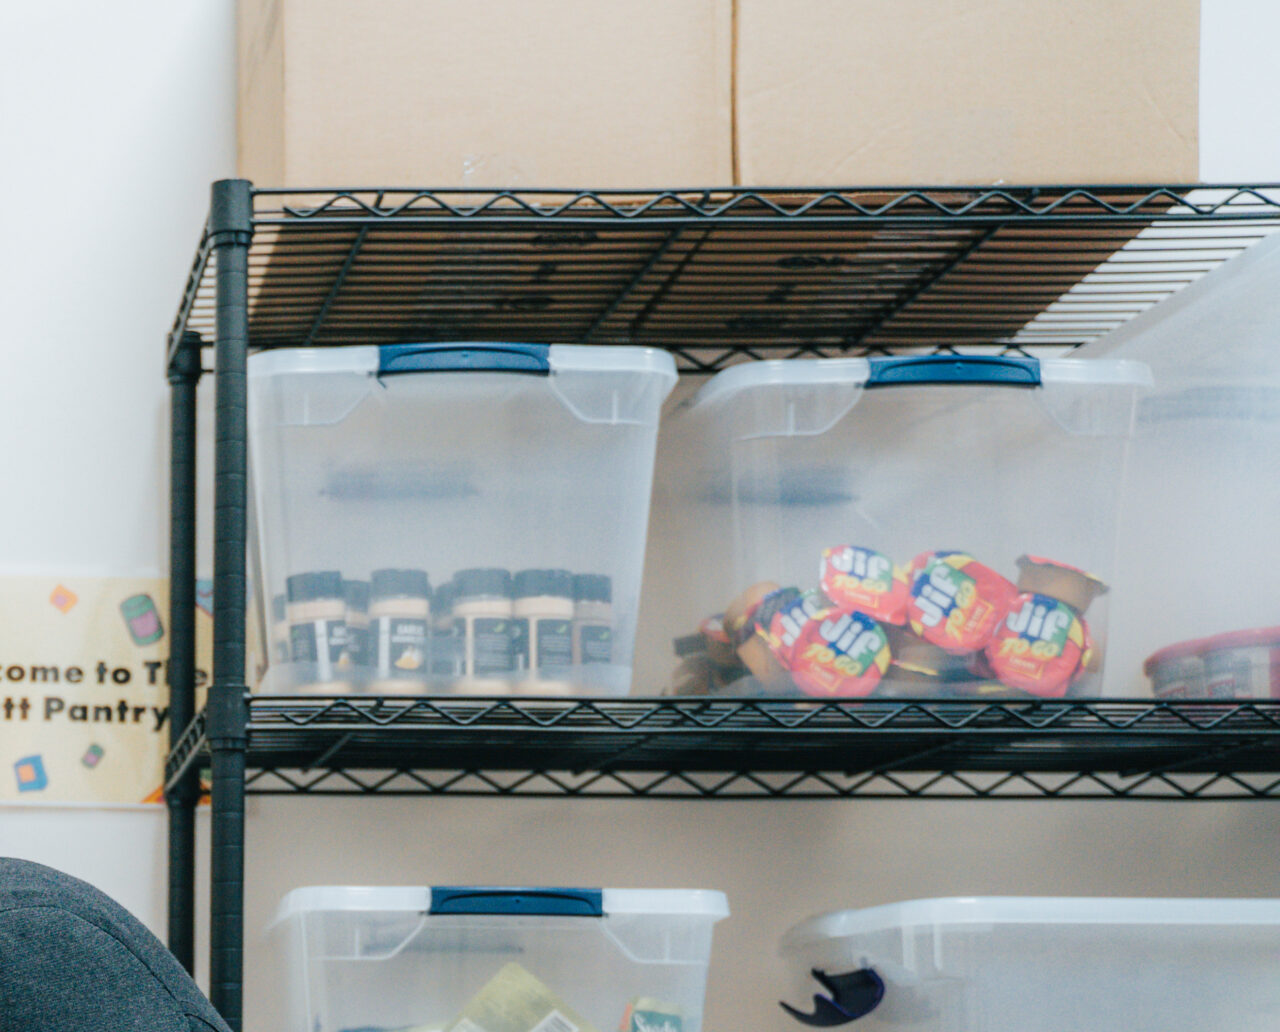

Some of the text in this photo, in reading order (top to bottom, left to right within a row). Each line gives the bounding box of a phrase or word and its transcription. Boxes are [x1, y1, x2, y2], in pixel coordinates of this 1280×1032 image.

[831, 548, 890, 581] Jif
[914, 564, 958, 628] Jif
[819, 613, 882, 661] Jif
[1006, 600, 1070, 642] Jif
[97, 661, 131, 685] to
[144, 661, 208, 689] Te
[43, 697, 169, 732] Pantry
